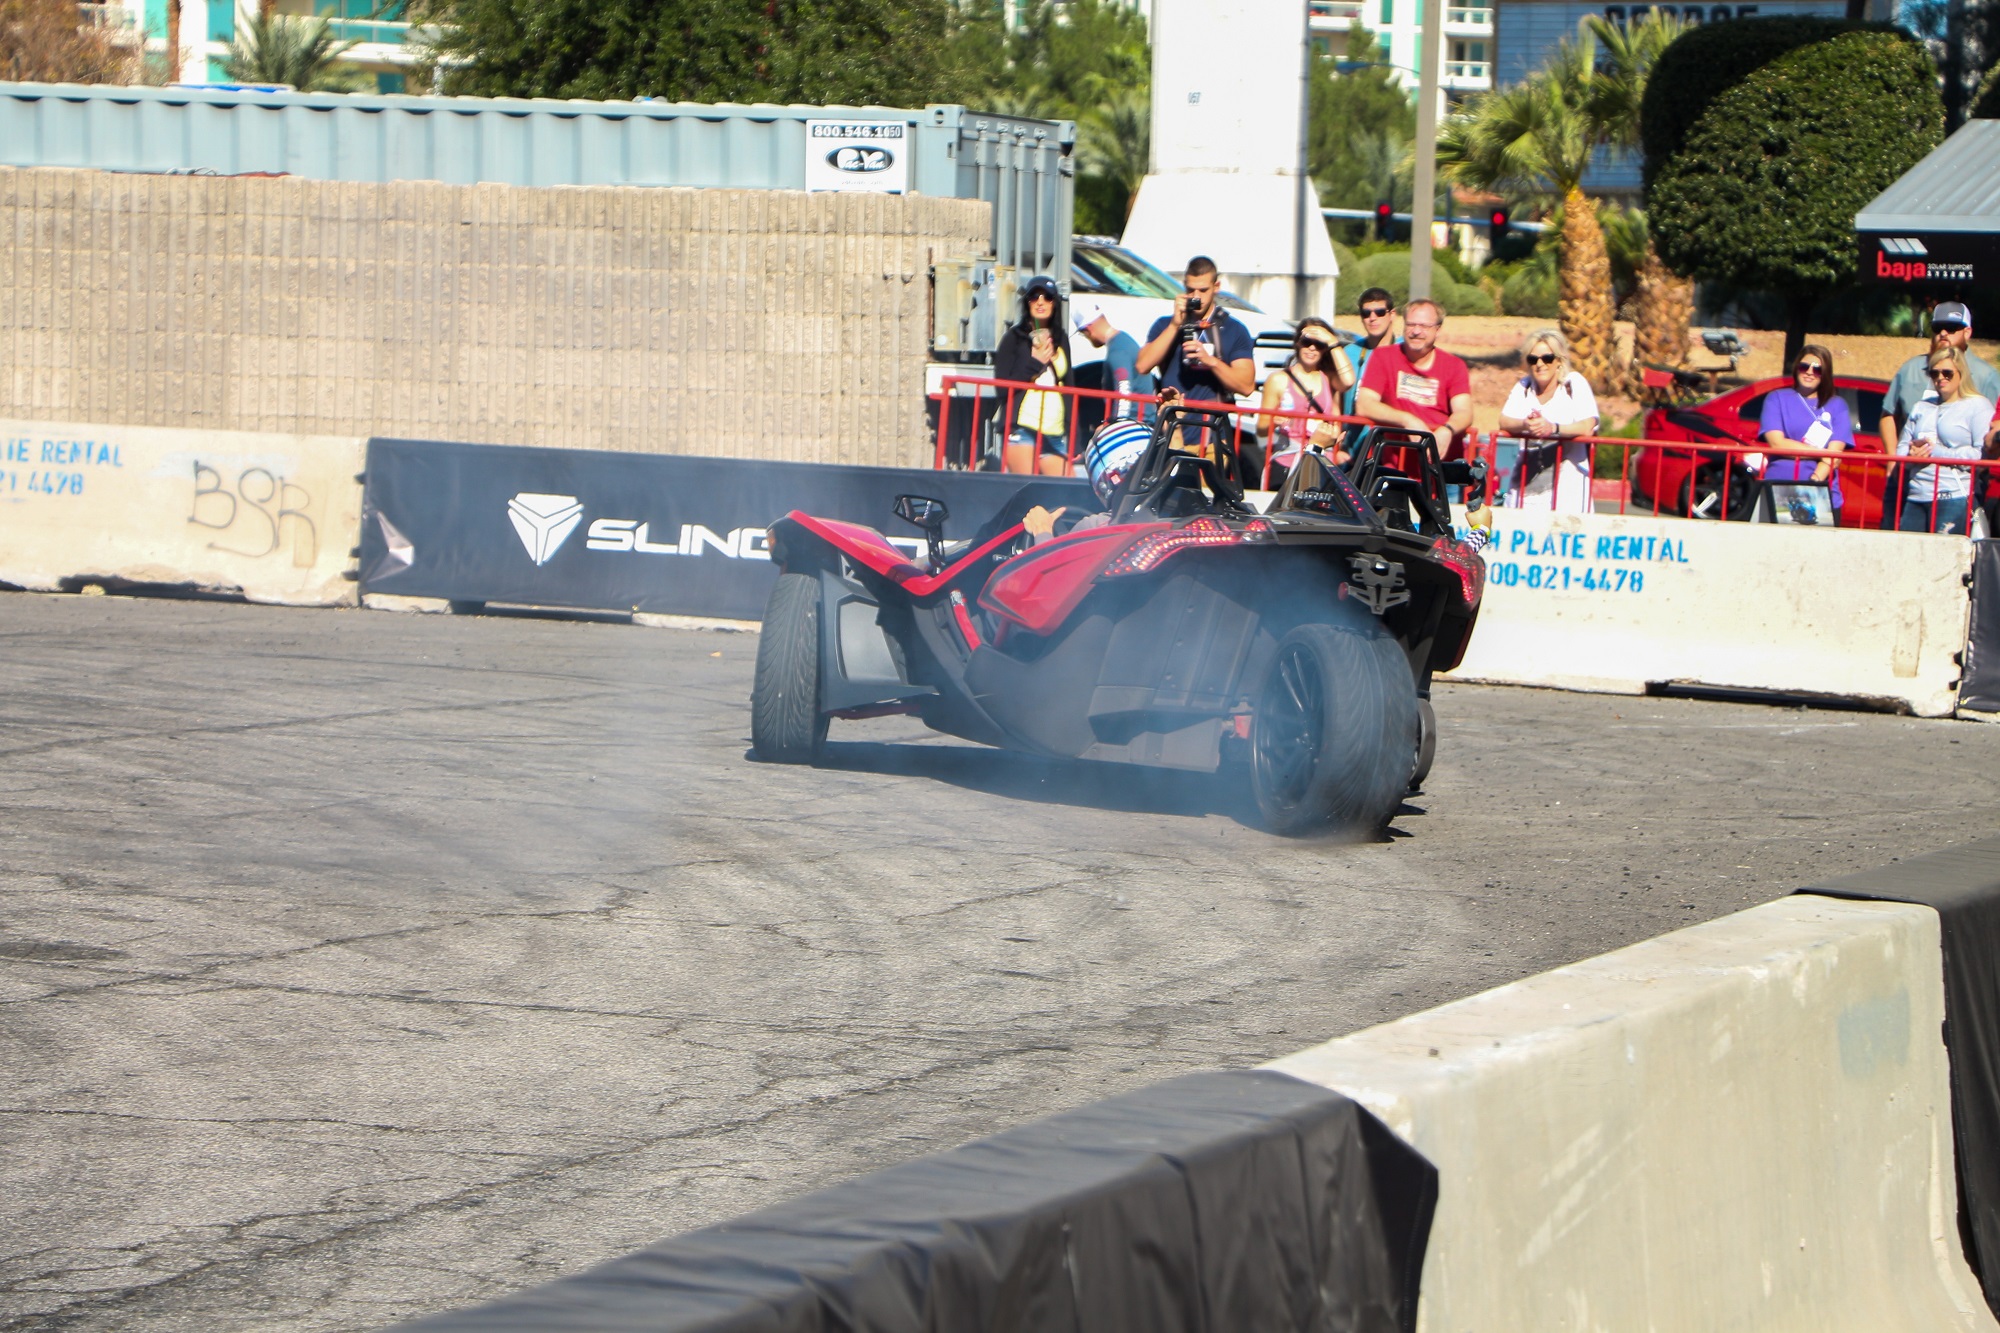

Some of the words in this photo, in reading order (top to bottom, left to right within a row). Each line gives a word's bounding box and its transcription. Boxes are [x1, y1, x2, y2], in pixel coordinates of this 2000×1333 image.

[1877, 250, 1926, 281] baja
[0, 438, 31, 462] TE
[40, 439, 123, 468] RENTAL
[1510, 529, 1586, 559] PLATE
[1595, 535, 1689, 563] RENTAL
[1484, 561, 1644, 592] 00-821-4478
